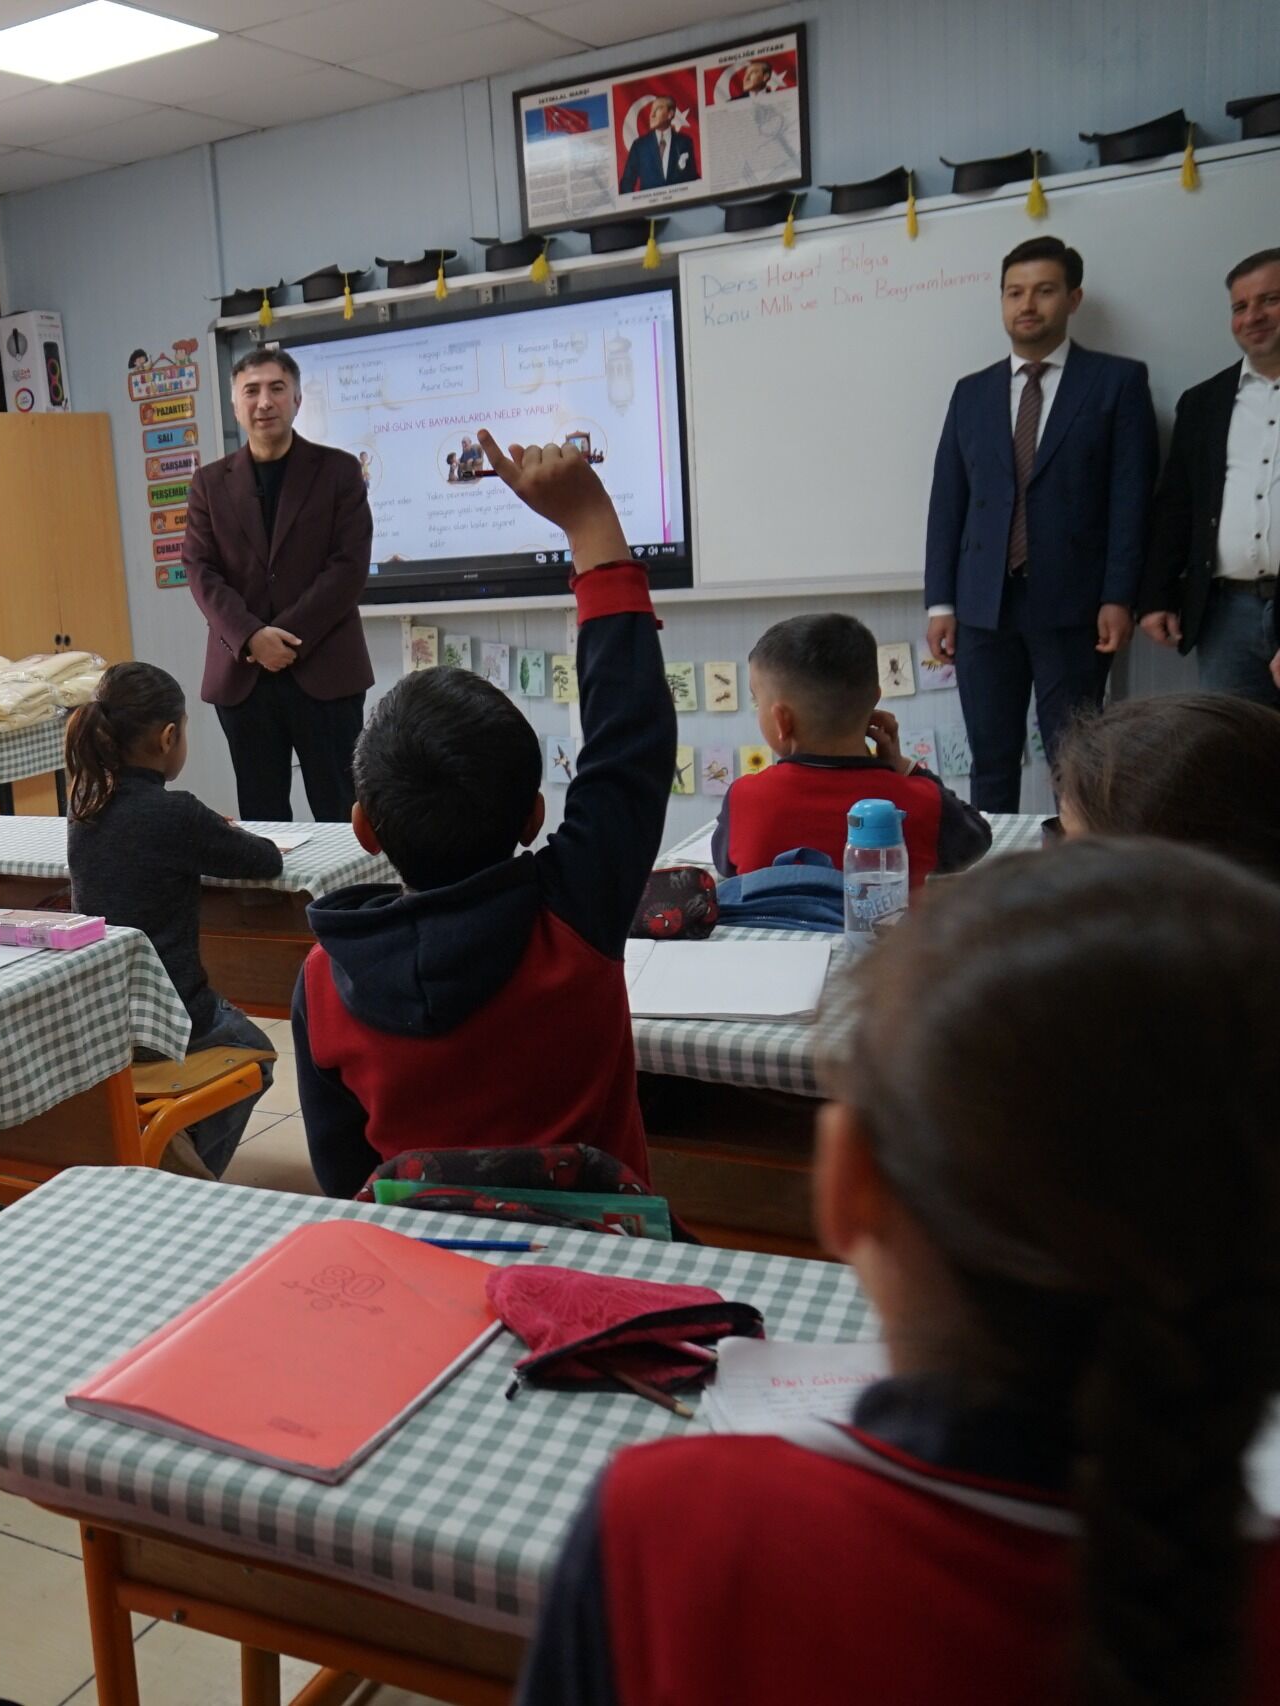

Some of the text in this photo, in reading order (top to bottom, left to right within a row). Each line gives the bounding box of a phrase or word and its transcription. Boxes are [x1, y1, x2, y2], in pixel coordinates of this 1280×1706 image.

[701, 274, 757, 299] Ders
[767, 252, 822, 292] Hayat
[703, 302, 749, 327] Konu
[800, 299, 817, 311] ve
[415, 419, 426, 429] VE
[429, 412, 492, 428] BAYRAMLARDA
[494, 407, 521, 418] NELER
[158, 432, 173, 444] SALI
